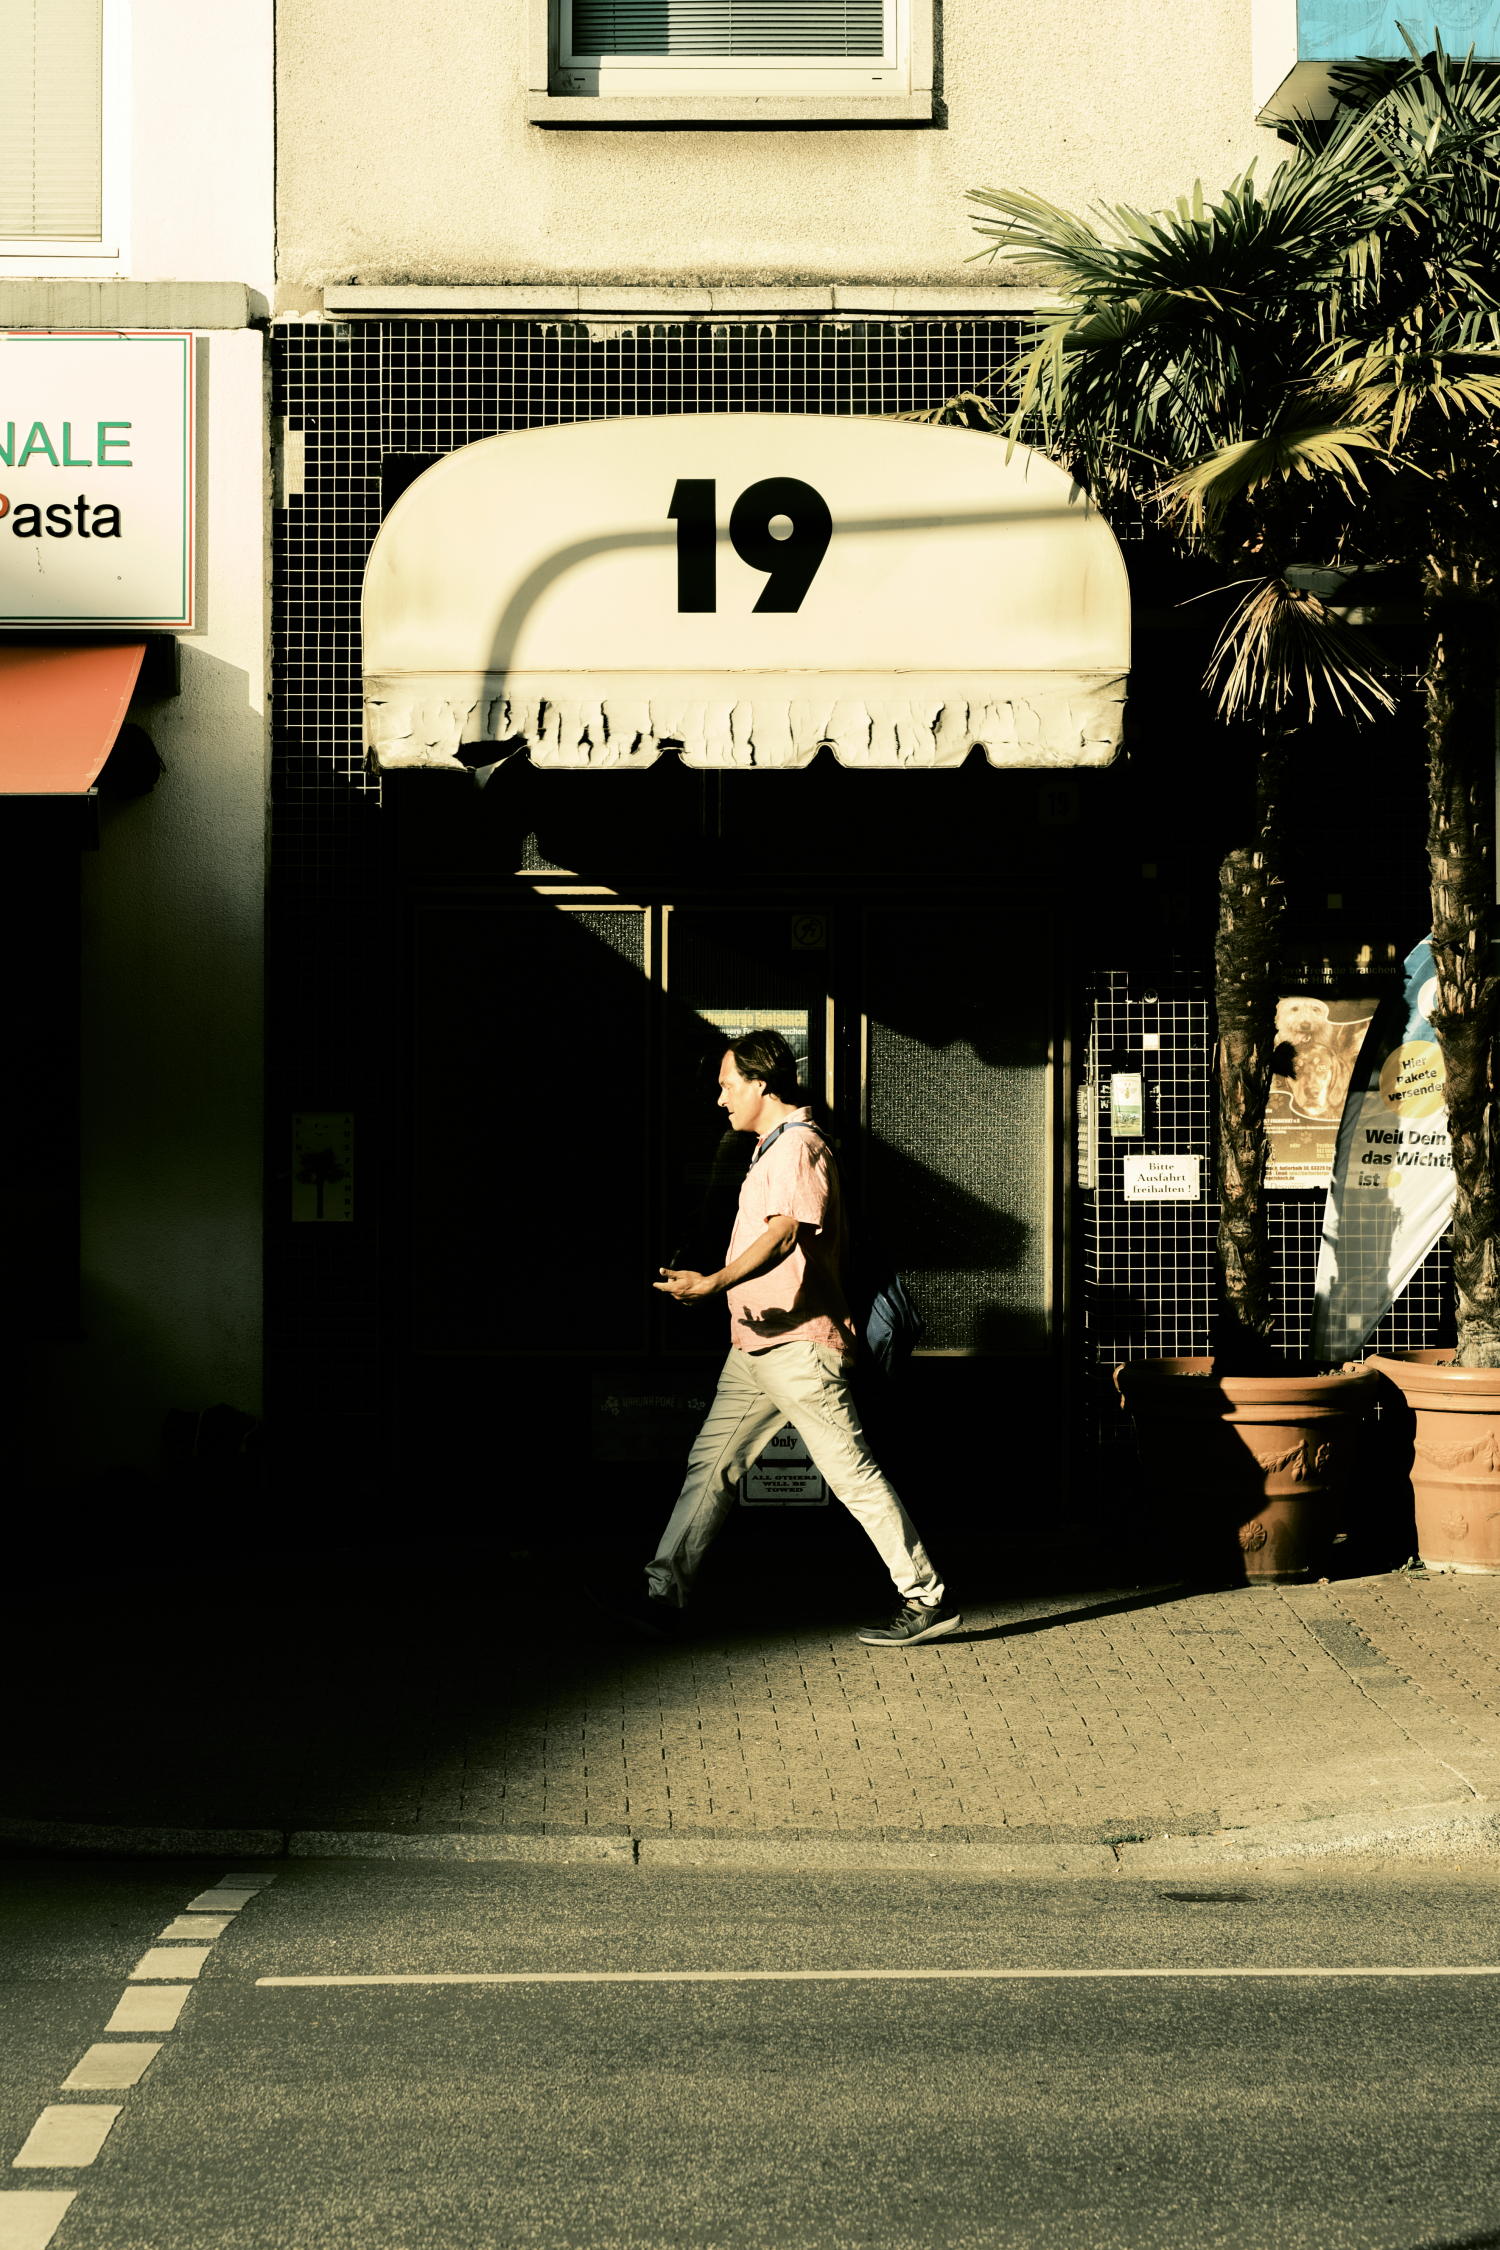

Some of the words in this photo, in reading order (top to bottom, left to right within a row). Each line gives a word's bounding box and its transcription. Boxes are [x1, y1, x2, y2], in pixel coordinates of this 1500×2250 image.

[667, 477, 833, 613] 19
[1047, 791, 1069, 816] 19
[1158, 893, 1192, 925] 19
[1304, 965, 1346, 975] Freunde
[1349, 965, 1397, 975] brauchen
[1312, 975, 1339, 985] Hilfe!
[776, 1027, 807, 1035] rauchen
[1402, 1057, 1427, 1070] Hier
[1397, 1069, 1437, 1086] Pakete
[1366, 1129, 1404, 1144] Weil
[1408, 1130, 1446, 1146] Dein
[1361, 1151, 1392, 1166] das
[1148, 1162, 1175, 1171] Bitte
[1137, 1173, 1186, 1182] Ausfahrt
[1358, 1171, 1380, 1186] ist
[1133, 1185, 1184, 1194] freihalten
[622, 1395, 654, 1408] KAHUNA
[771, 1436, 798, 1450] Only
